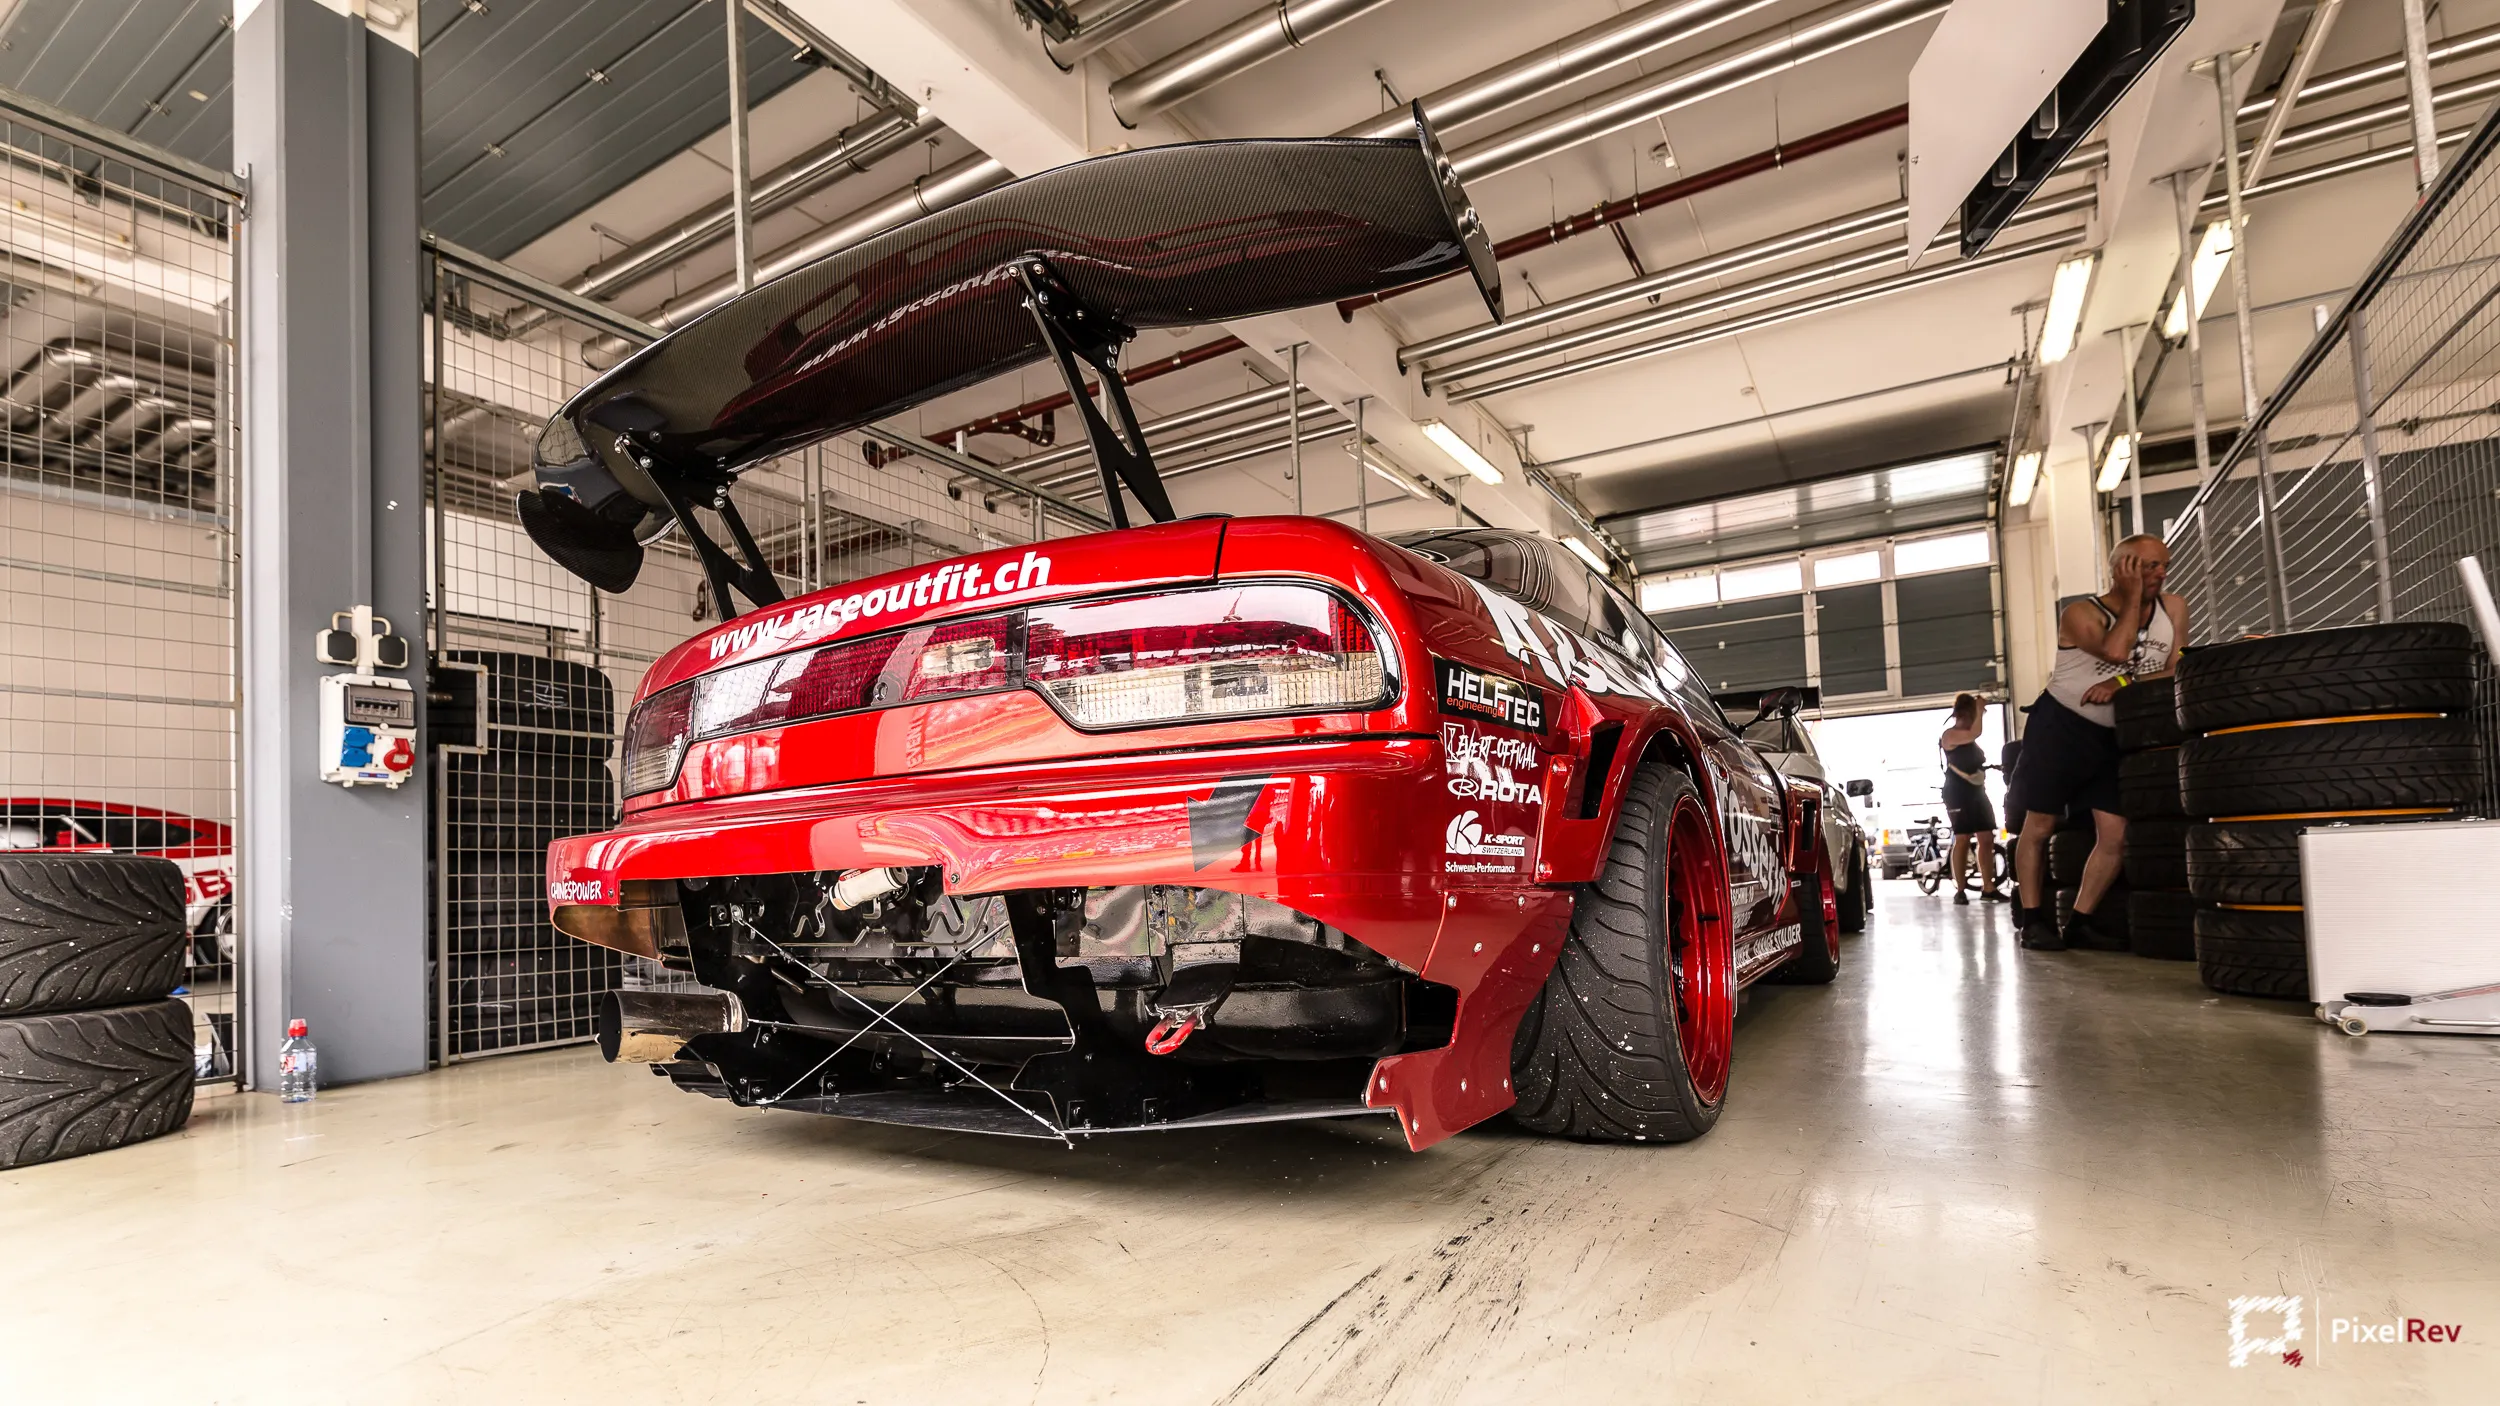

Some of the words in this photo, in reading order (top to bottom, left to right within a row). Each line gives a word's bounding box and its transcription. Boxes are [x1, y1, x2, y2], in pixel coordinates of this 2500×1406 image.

[708, 551, 1052, 660] www.raceoutfit.ch
[1446, 696, 1498, 718] engineering
[1479, 780, 1542, 804] ROTA
[1484, 834, 1525, 845] K-SPORT
[1481, 846, 1523, 856] SWITZERLAND
